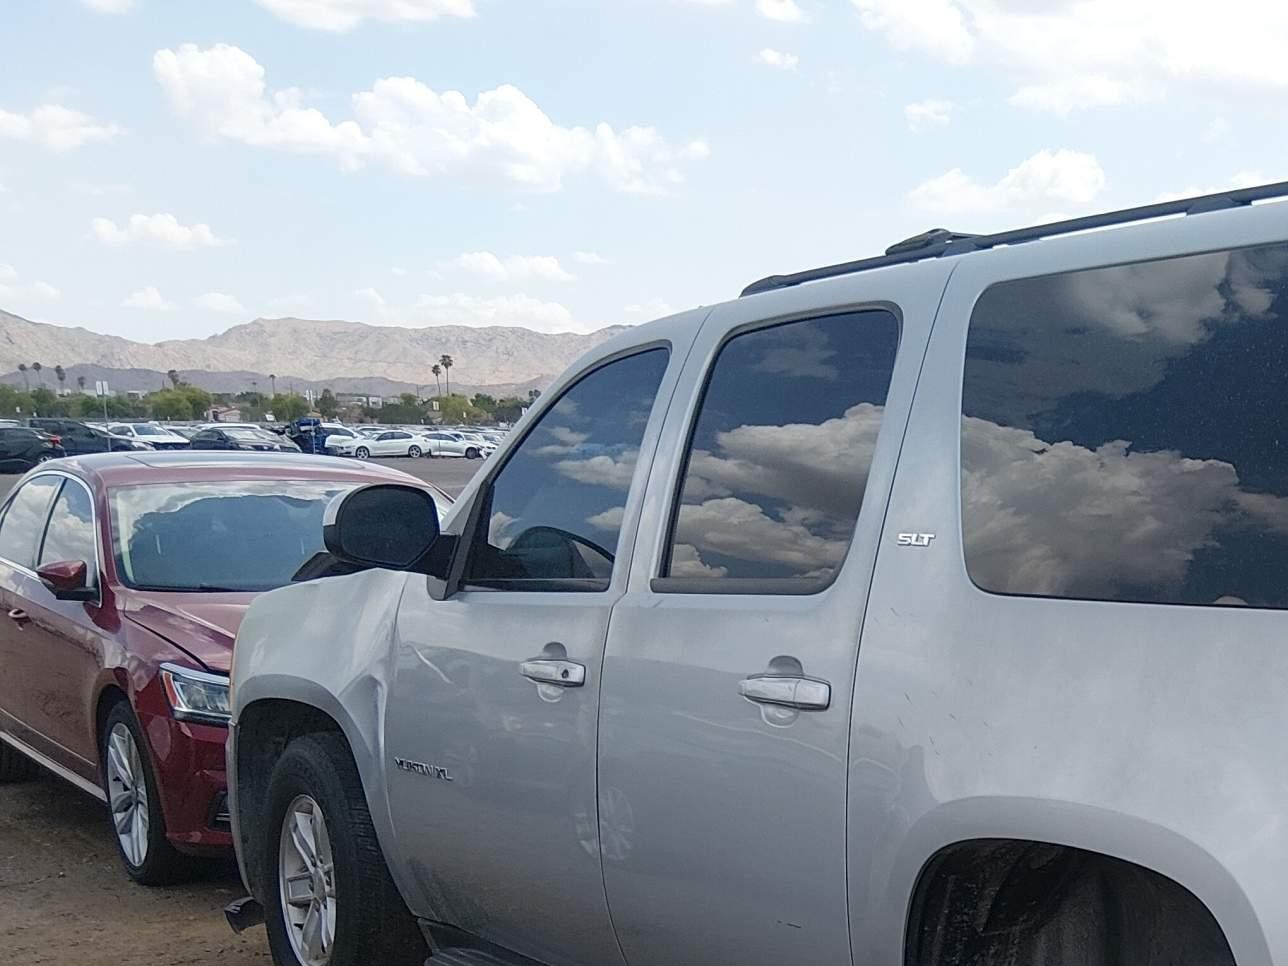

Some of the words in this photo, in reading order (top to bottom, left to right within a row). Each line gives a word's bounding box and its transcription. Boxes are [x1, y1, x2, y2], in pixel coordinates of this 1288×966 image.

[897, 533, 936, 547] SLT
[394, 756, 432, 775] YUKON
[435, 765, 454, 781] XL
